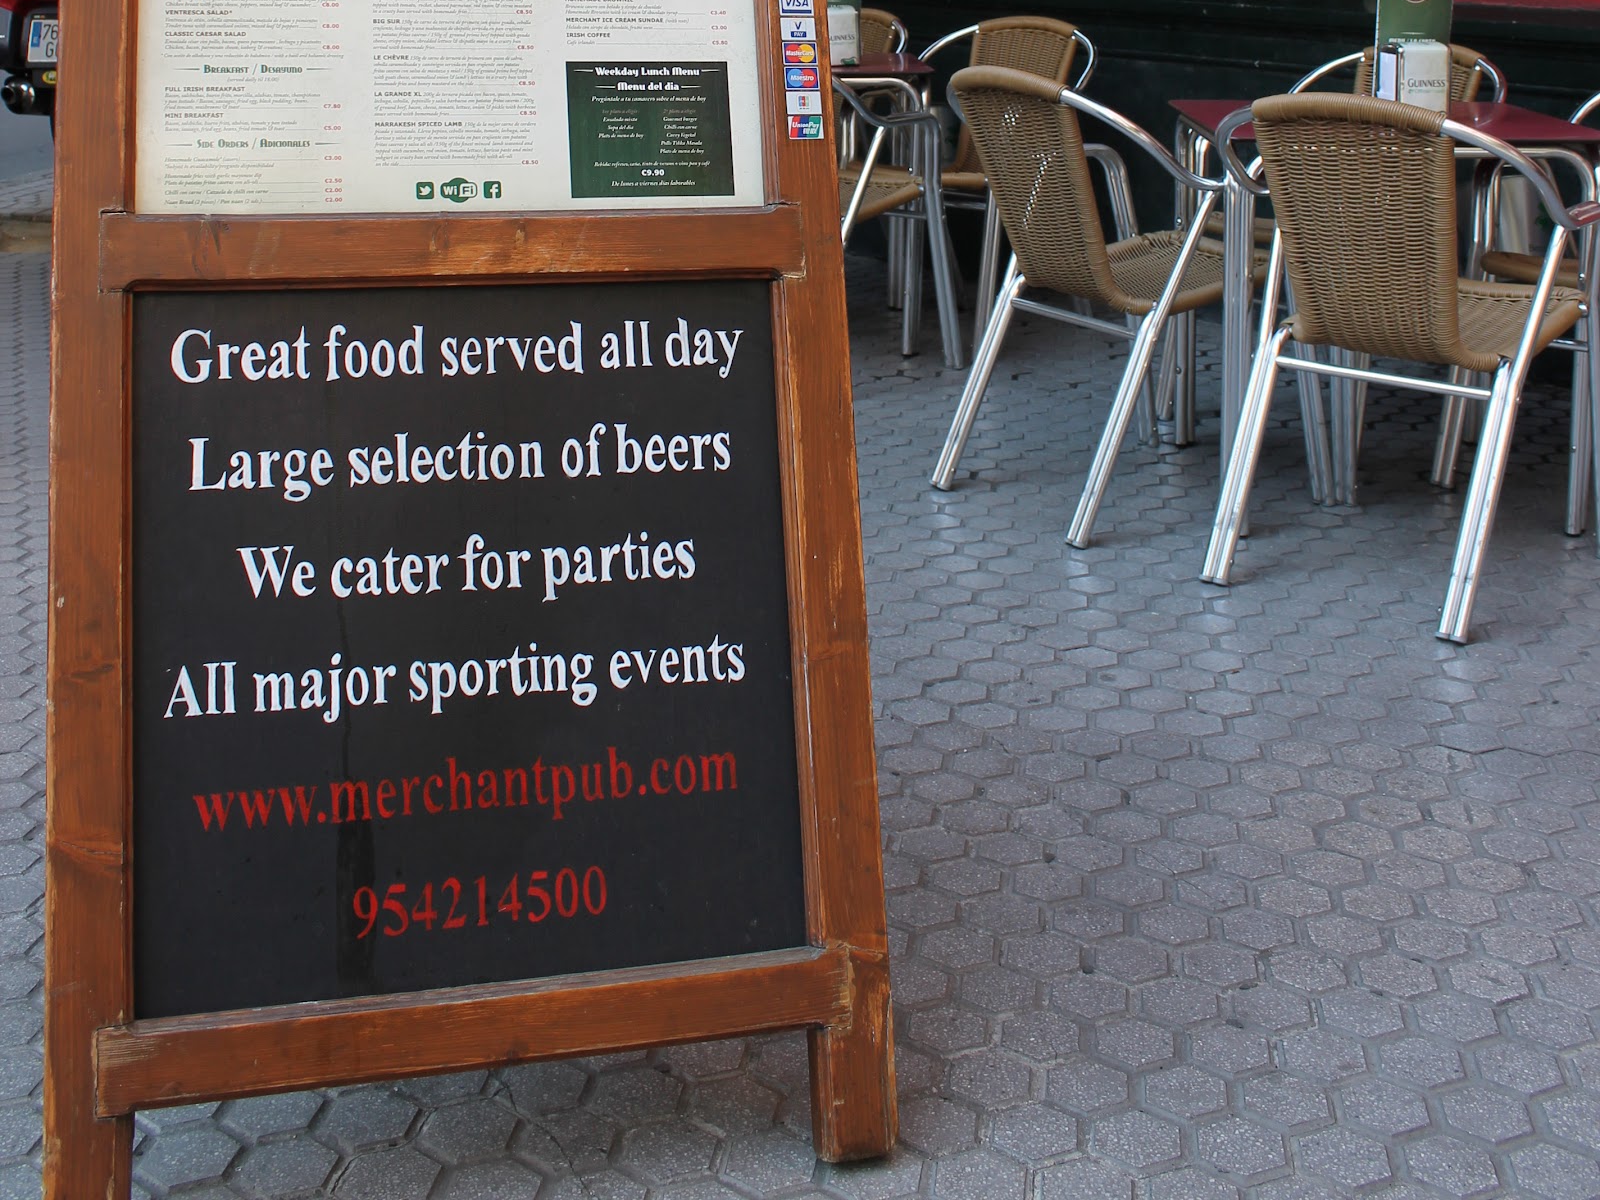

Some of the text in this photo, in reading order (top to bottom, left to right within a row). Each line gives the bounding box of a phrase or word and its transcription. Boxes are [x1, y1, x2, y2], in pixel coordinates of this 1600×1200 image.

[829, 34, 856, 42] UINNESS
[382, 53, 409, 61] CHÈVRE
[203, 63, 303, 74] BREAKFAST DESAYUNO
[594, 66, 700, 78] Weekday Lunch Menu
[790, 74, 815, 82] Maestro
[1407, 77, 1446, 88] GUINNESS
[617, 81, 680, 91] Menu del dia
[791, 121, 820, 130] UnionPay
[196, 138, 311, 149] SIDE ORDERS ADICIONALES
[641, 168, 665, 177] €9.90
[169, 317, 745, 384] Great food served all day
[188, 421, 733, 503] Large selection of beers
[235, 529, 698, 604] We cater for parties
[162, 632, 748, 725] All major sporting events
[191, 746, 739, 833] www.merchantpub.com
[352, 864, 609, 941] 954214500
